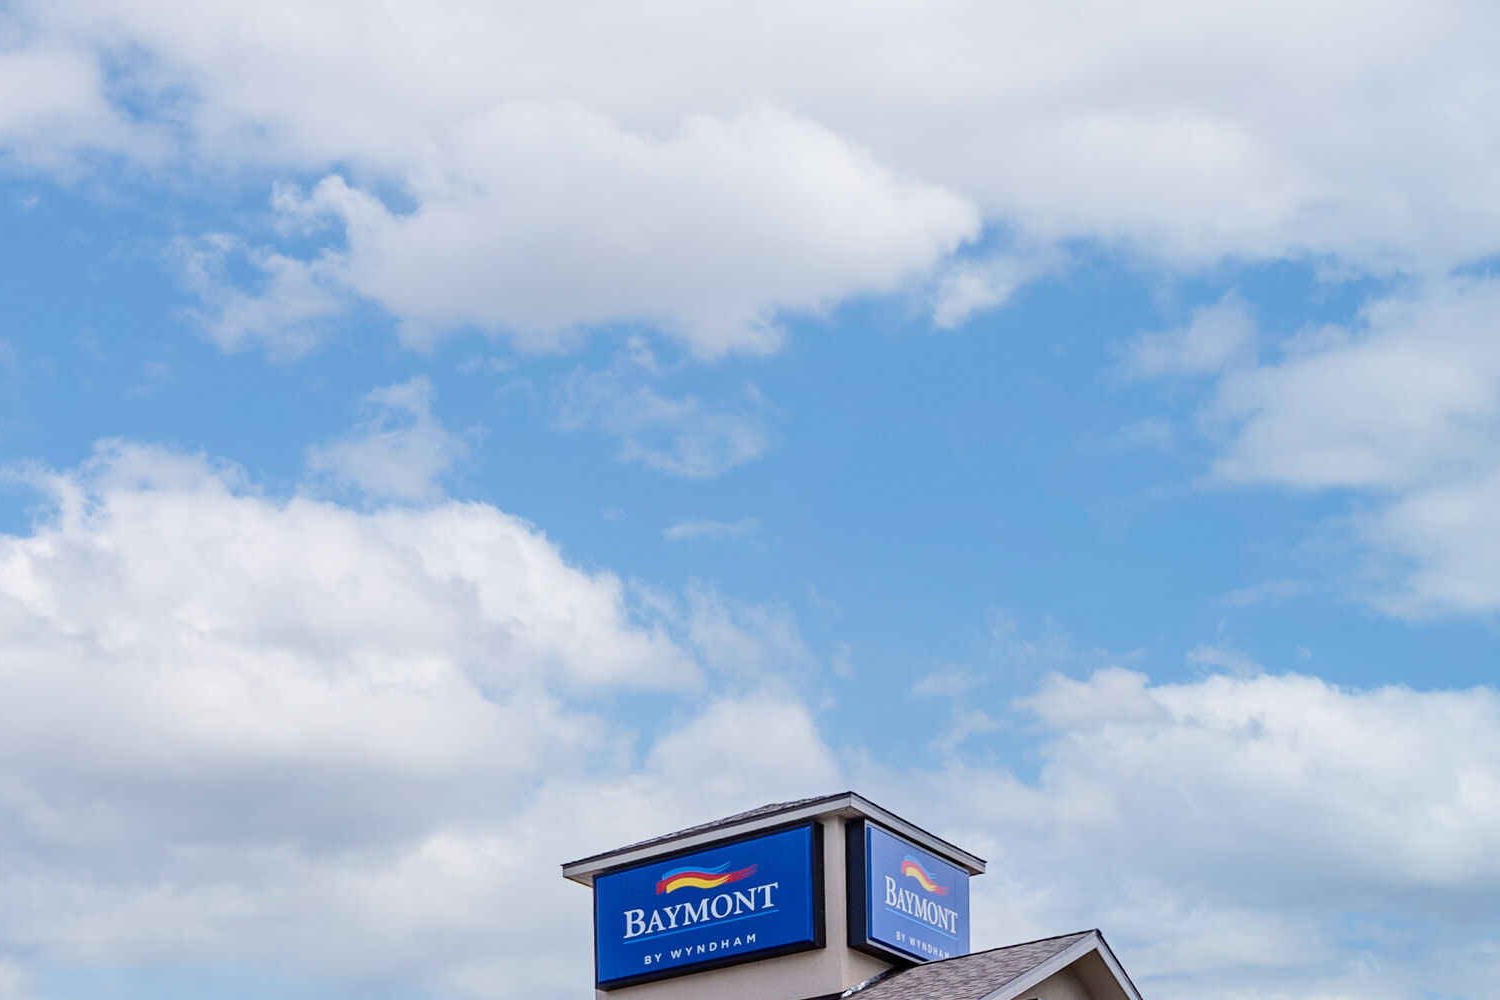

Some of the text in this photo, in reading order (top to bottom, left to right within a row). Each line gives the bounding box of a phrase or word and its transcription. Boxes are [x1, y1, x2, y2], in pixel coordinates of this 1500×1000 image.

[623, 882, 779, 939] BAYMONT
[884, 875, 958, 934] BAYMONT
[644, 933, 757, 965] BY WYNDHAM
[896, 930, 951, 959] BY WYNDHAM
